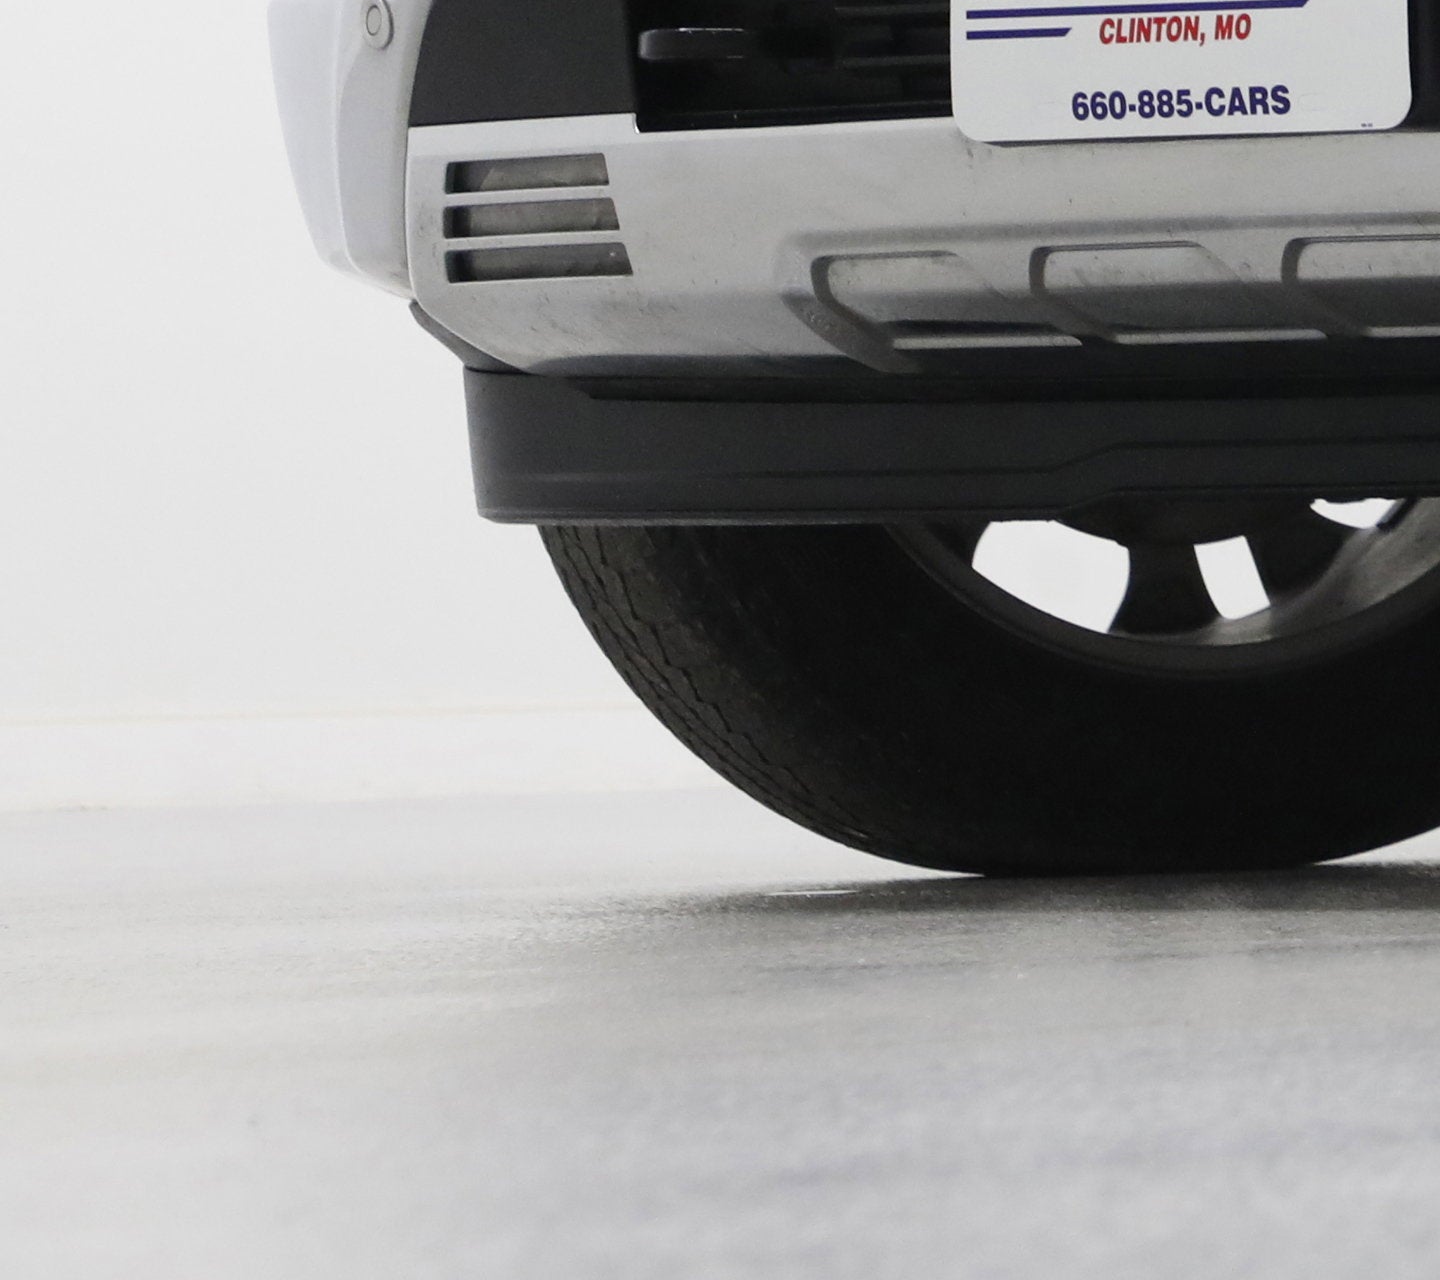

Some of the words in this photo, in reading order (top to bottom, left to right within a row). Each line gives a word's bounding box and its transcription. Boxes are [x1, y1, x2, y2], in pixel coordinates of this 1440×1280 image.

[1099, 15, 1206, 47] CLINTON,
[1214, 13, 1252, 40] MO
[1071, 85, 1291, 121] 660-885-CARS
